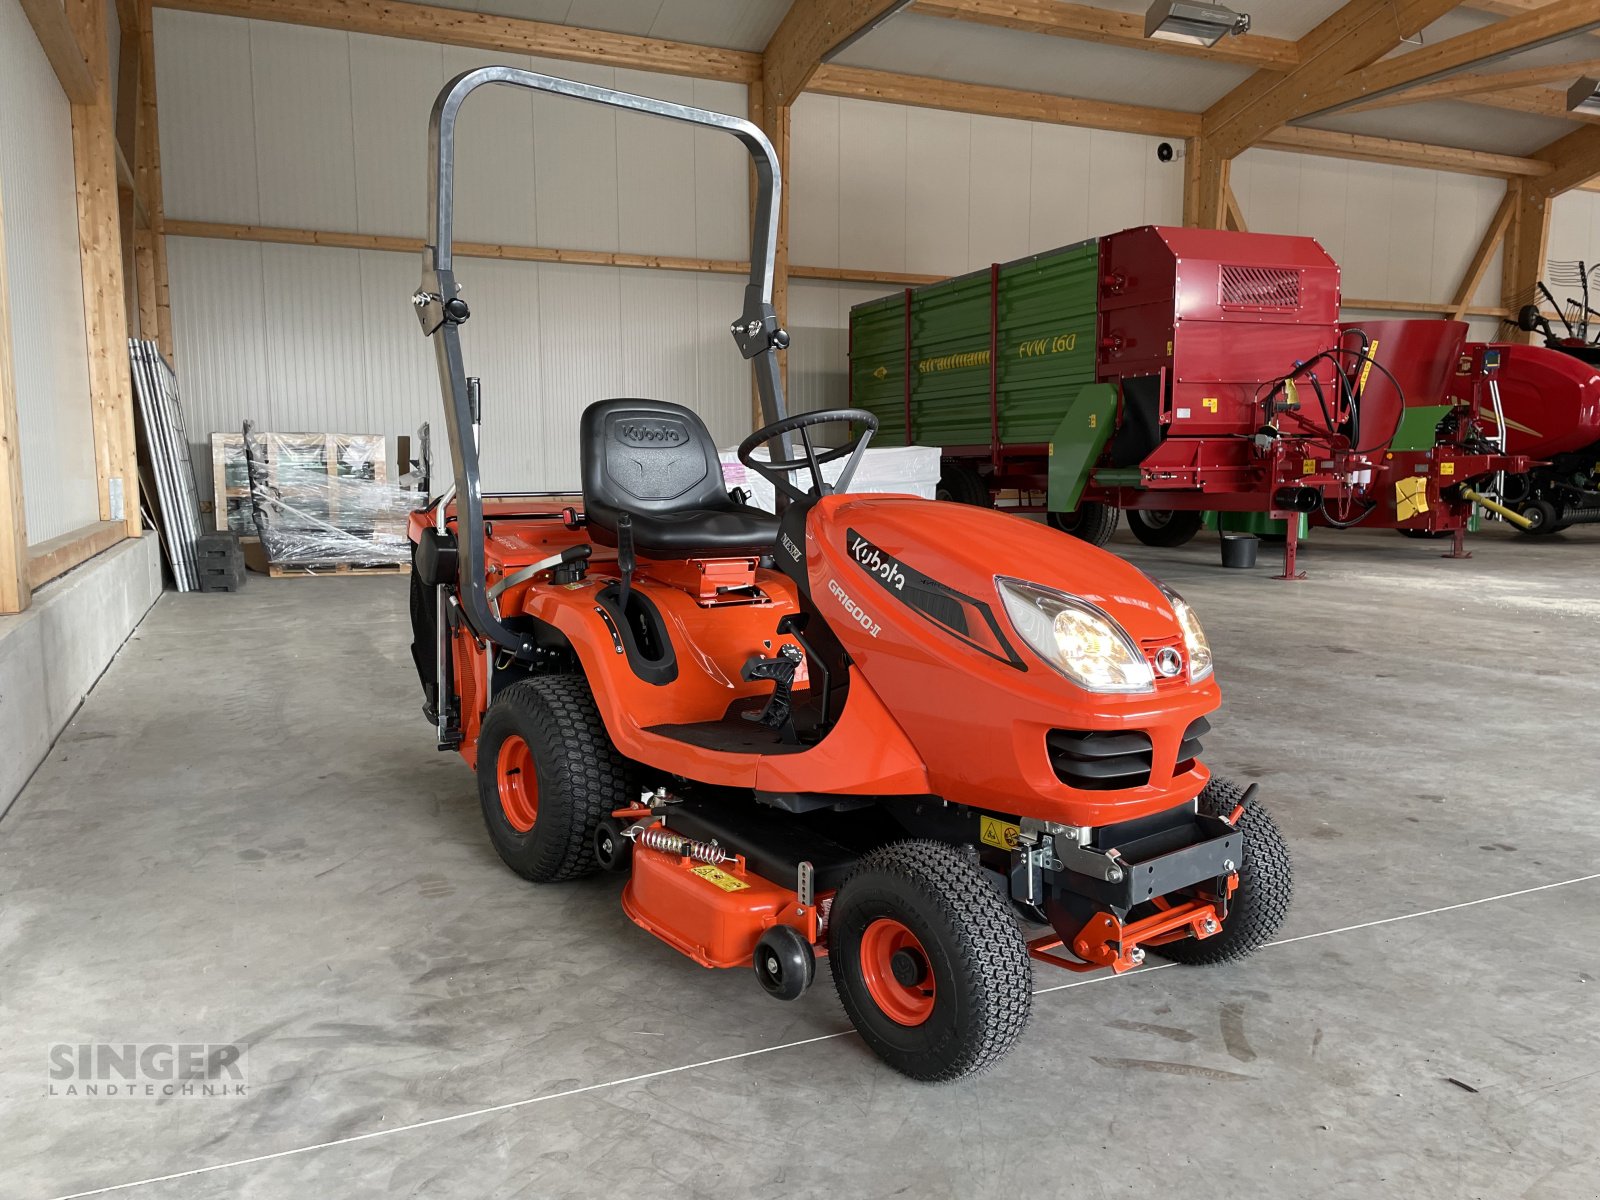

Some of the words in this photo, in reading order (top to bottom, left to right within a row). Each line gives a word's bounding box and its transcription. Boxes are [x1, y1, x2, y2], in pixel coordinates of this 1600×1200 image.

[1019, 338, 1050, 358] FVW
[1051, 333, 1077, 353] 160
[919, 351, 991, 372] strautmann
[621, 425, 680, 441] Kubota
[851, 537, 905, 591] Kubota
